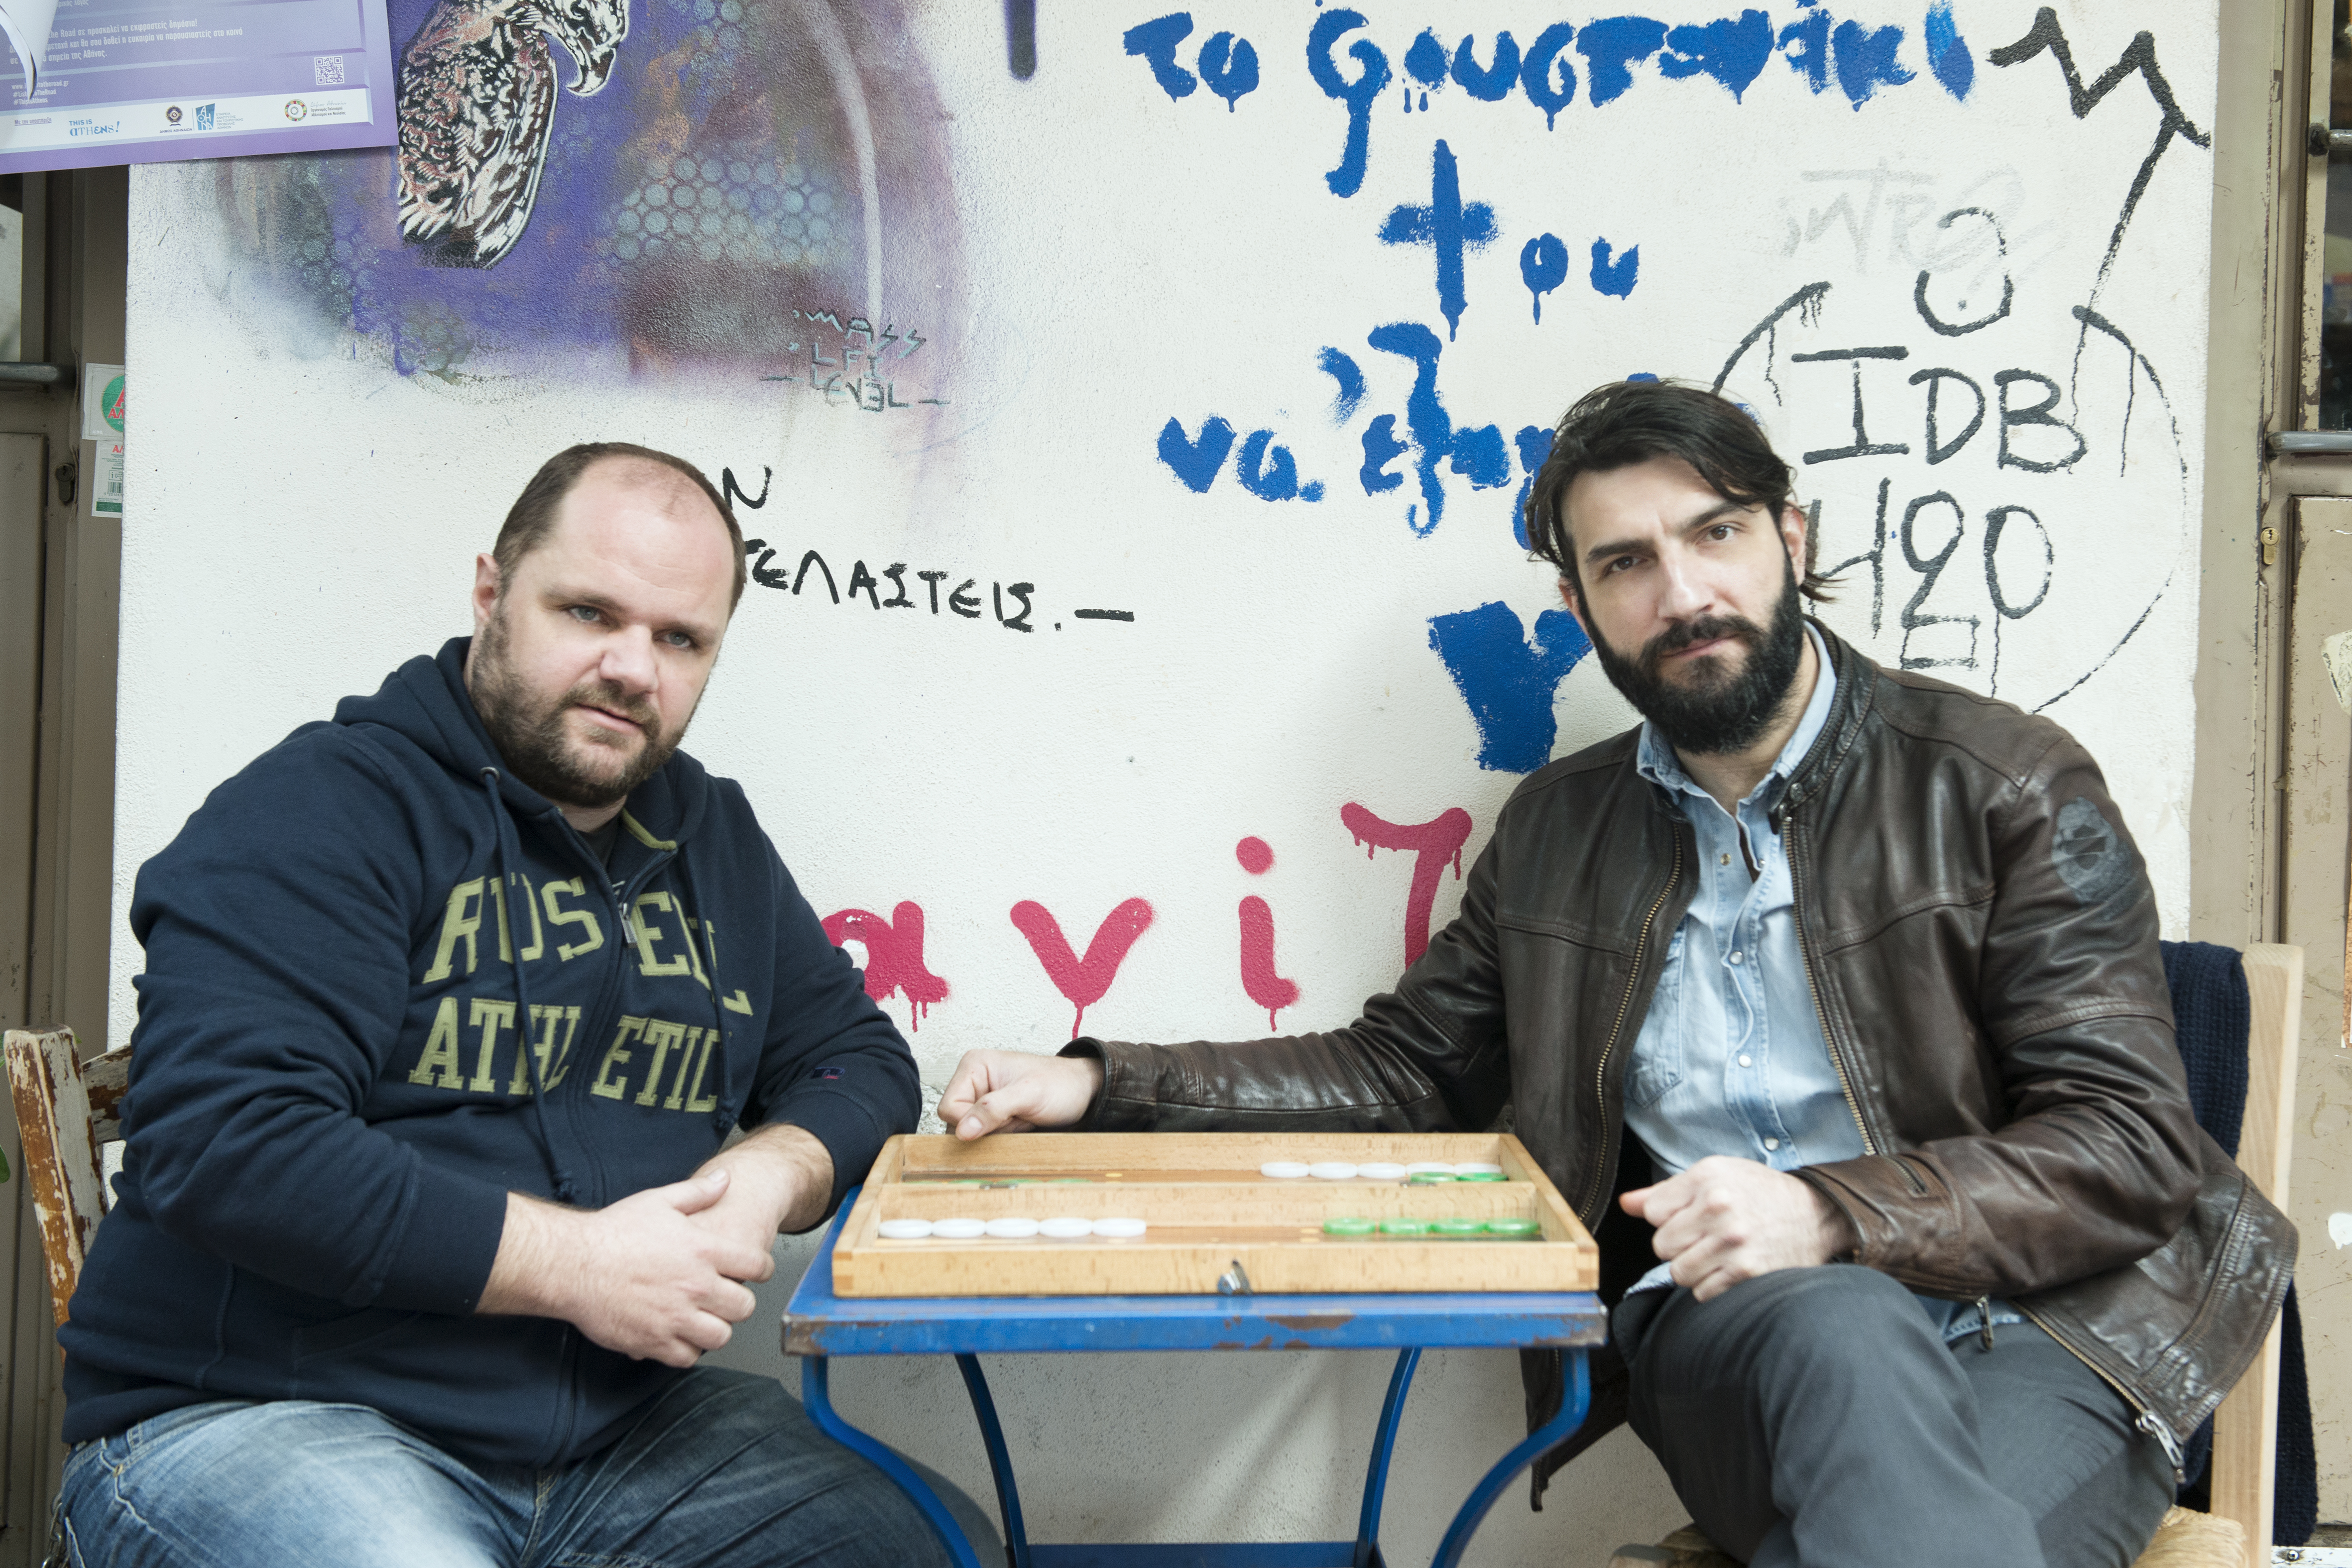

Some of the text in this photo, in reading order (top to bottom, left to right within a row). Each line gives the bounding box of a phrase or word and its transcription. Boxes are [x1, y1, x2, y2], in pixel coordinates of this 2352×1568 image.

[60, 28, 76, 37] Road
[130, 21, 167, 32] εκφραστείς
[169, 18, 198, 29] δημόσια!
[104, 36, 120, 45] δοθεί
[128, 33, 155, 43] ευκαιρία
[166, 29, 212, 41] παρουσιαστείς
[226, 27, 243, 36] κοινό
[71, 52, 82, 60] της
